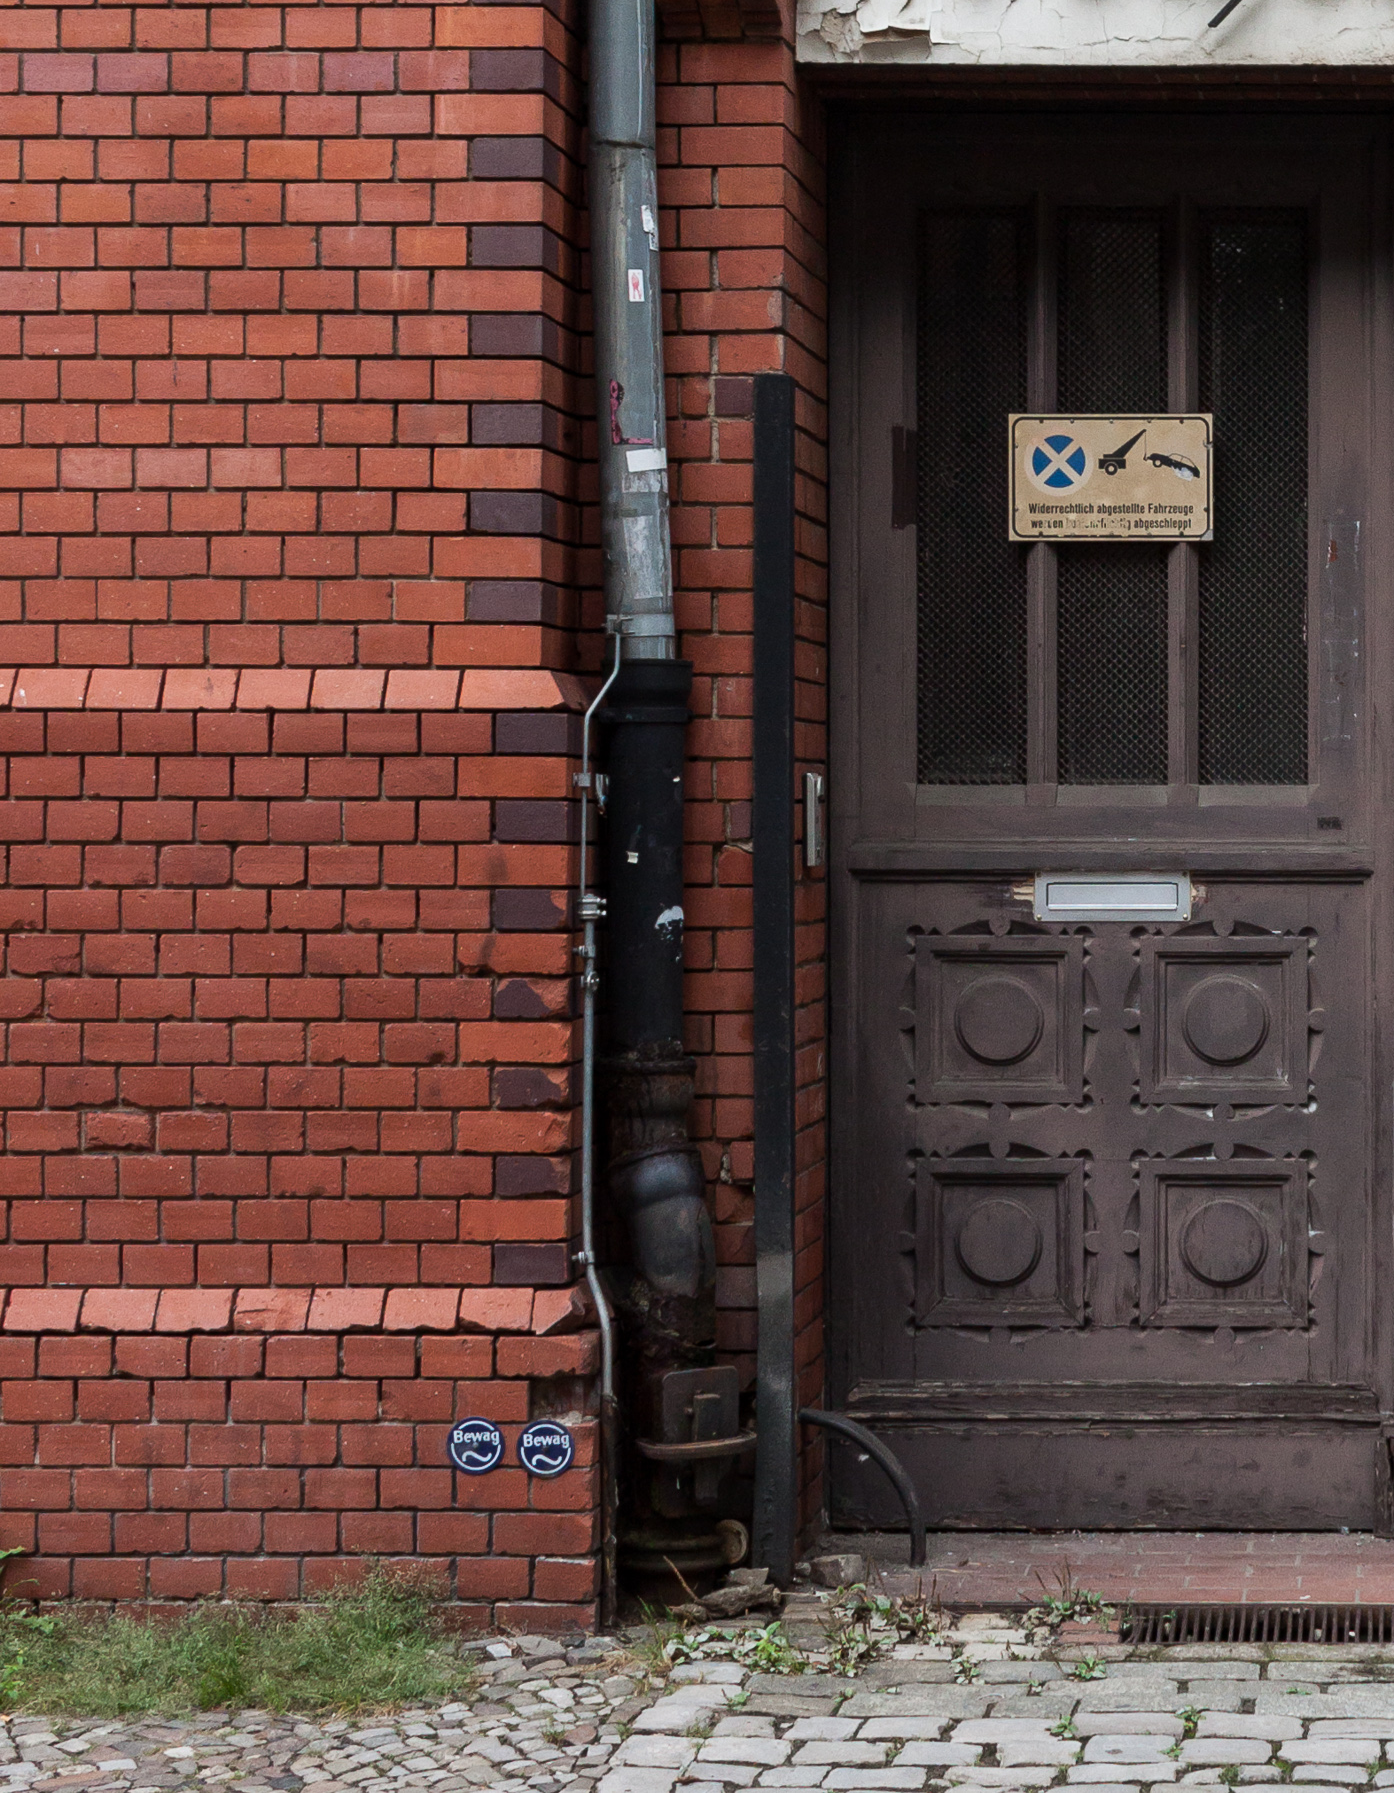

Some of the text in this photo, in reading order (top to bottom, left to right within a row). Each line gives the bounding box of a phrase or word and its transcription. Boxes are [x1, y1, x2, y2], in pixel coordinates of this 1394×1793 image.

[1028, 503, 1194, 516] Widerrechtlich abgestellte Fahrzeuge
[1031, 518, 1064, 529] ween
[1134, 518, 1192, 531] abgeschleppt
[453, 1430, 500, 1446] Bewag
[523, 1434, 570, 1449] Bewag
